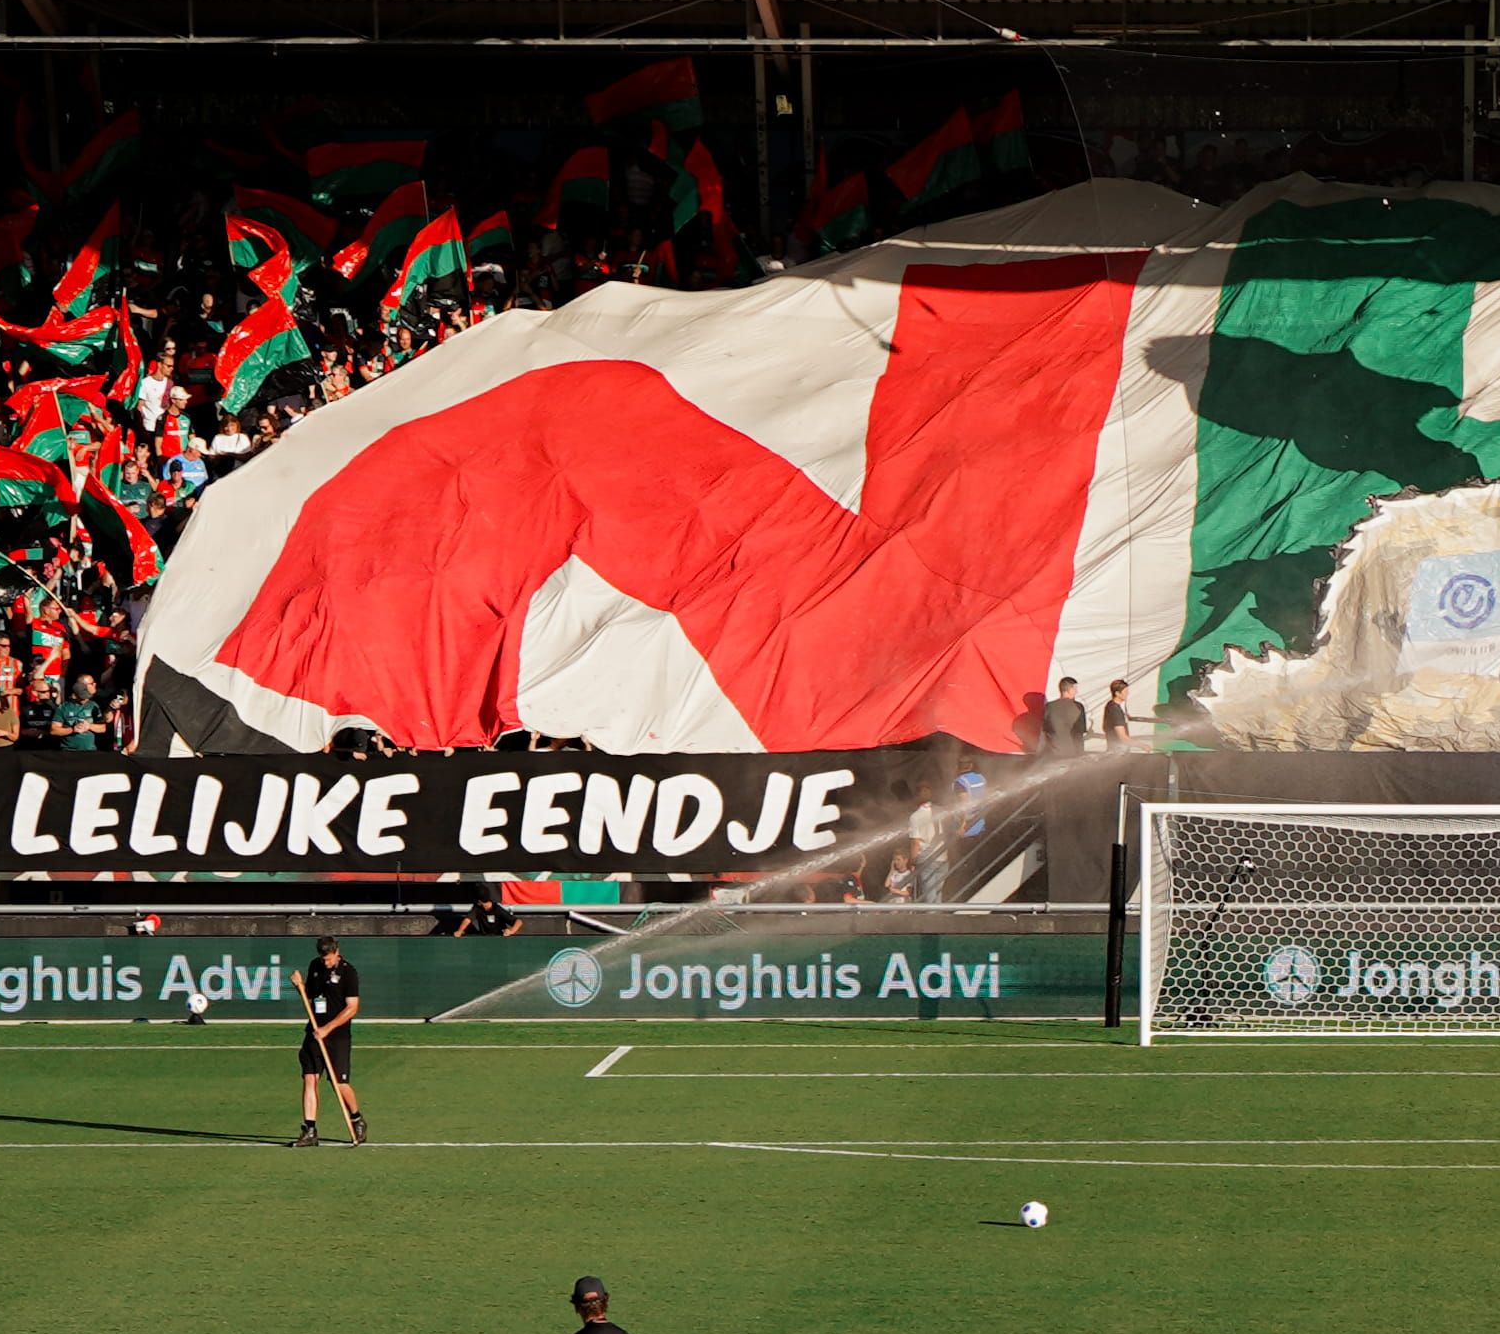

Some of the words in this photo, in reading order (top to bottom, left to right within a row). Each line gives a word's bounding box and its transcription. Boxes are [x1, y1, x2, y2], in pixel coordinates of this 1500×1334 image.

[11, 772, 419, 855] LELIJKE
[459, 769, 854, 855] EENDJE
[160, 955, 281, 1001] Advi
[620, 953, 860, 1010] Jonghuis
[878, 952, 1000, 998] Advi
